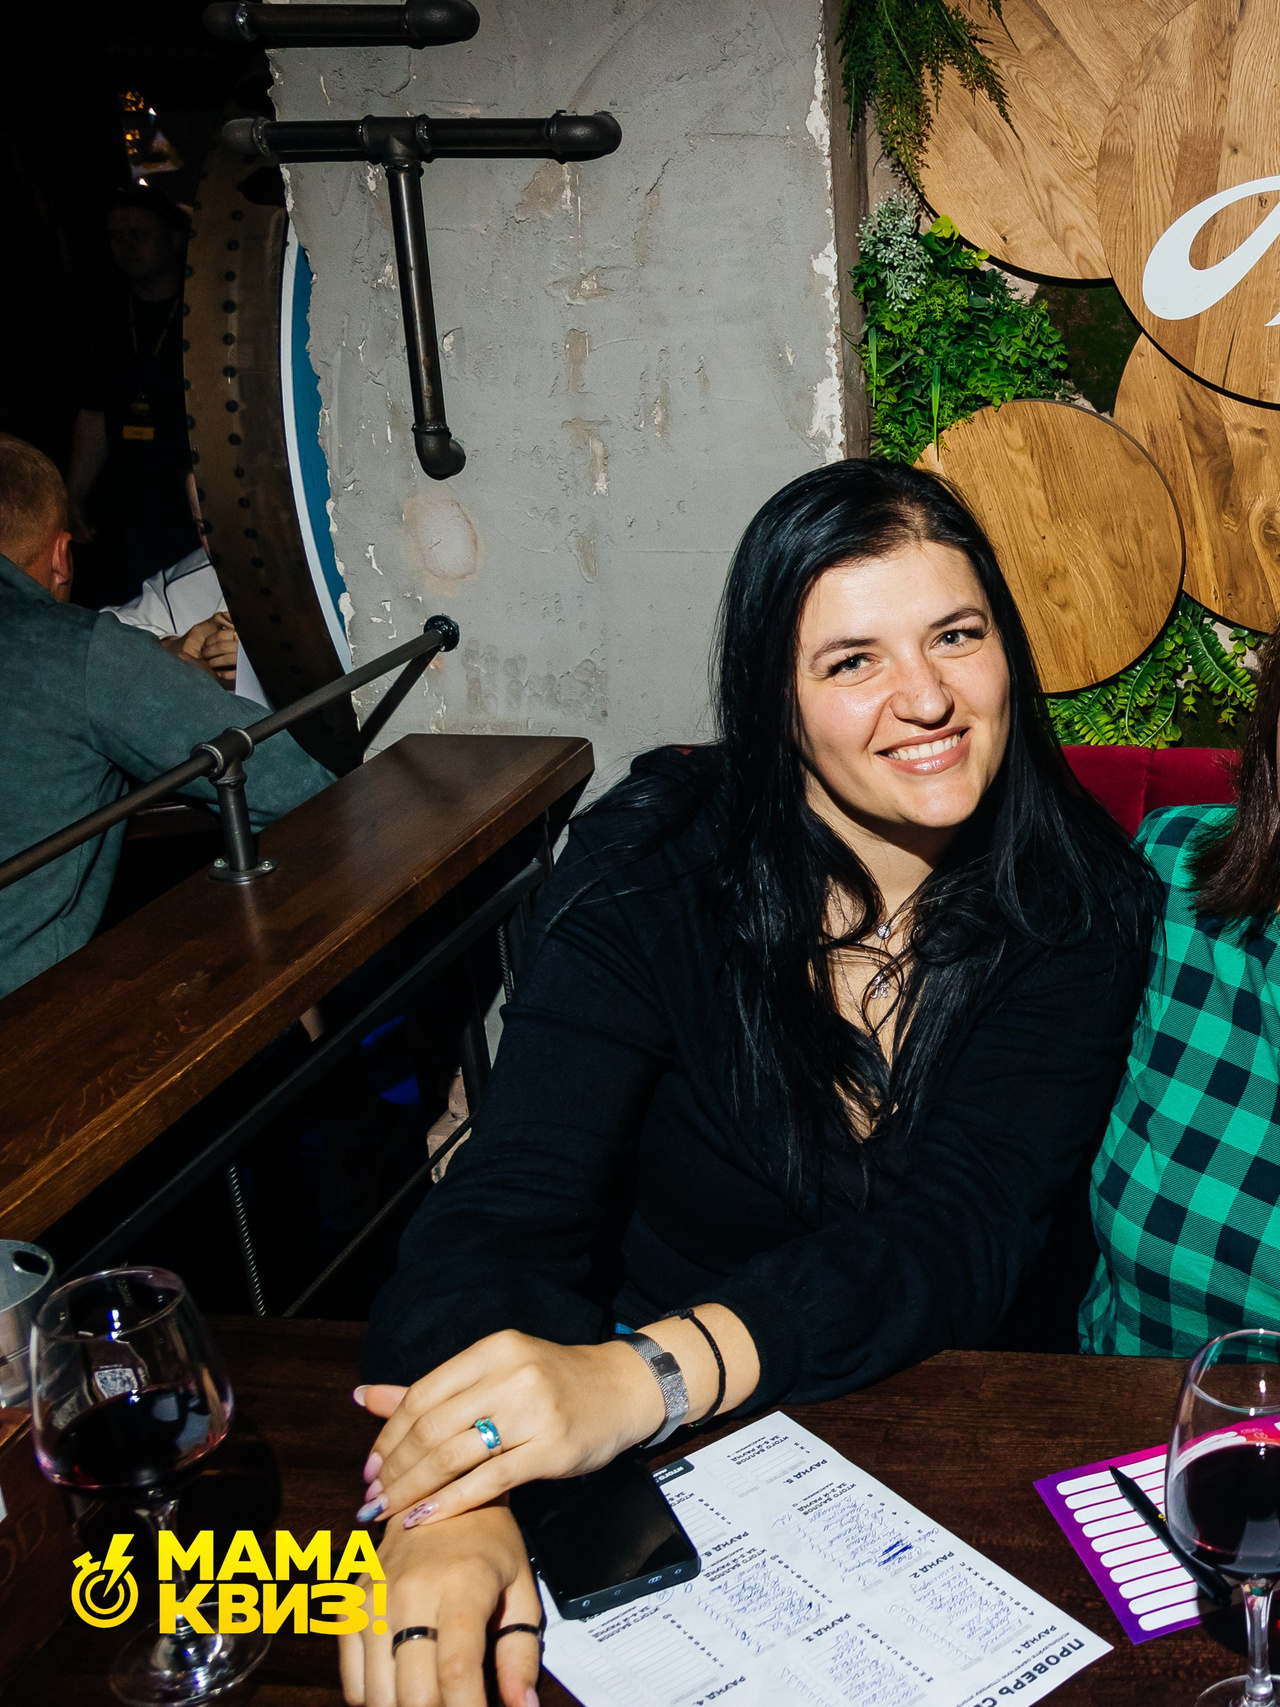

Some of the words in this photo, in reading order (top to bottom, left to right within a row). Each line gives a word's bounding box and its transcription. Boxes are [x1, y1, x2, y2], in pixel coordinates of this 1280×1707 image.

[730, 1447, 756, 1462] РАУНД
[792, 1458, 828, 1479] РАУНД
[796, 1496, 823, 1512] РАУНД
[711, 1531, 749, 1552] РАУНД
[918, 1551, 955, 1573] РАУНД
[812, 1613, 851, 1636] РАУНД
[1020, 1624, 1057, 1649] РАУНД
[998, 1638, 1085, 1695] ПРОВЕРЬ
[705, 1676, 746, 1700] РАУНД
